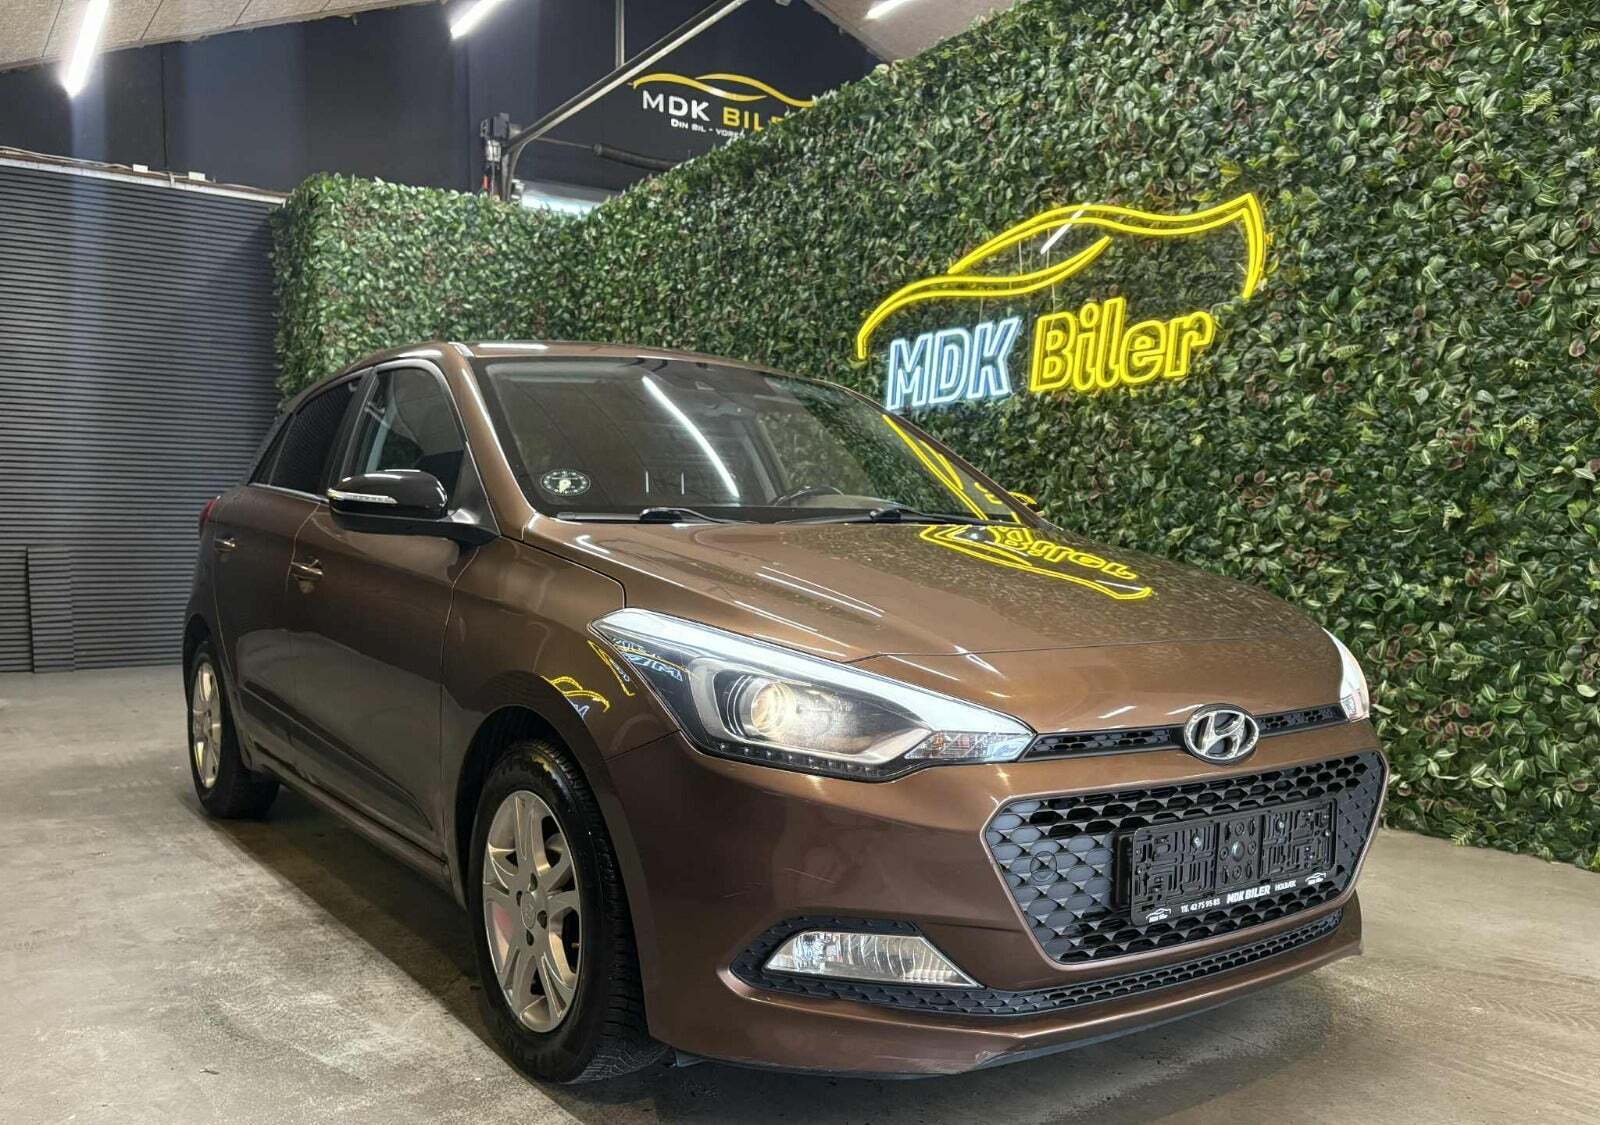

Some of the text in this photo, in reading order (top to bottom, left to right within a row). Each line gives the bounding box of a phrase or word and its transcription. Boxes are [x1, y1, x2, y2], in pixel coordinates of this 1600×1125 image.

[642, 90, 710, 122] MDK
[887, 297, 1215, 410] MDK Biler
[1226, 890, 1244, 904] MDK
[1244, 884, 1271, 900] BILER
